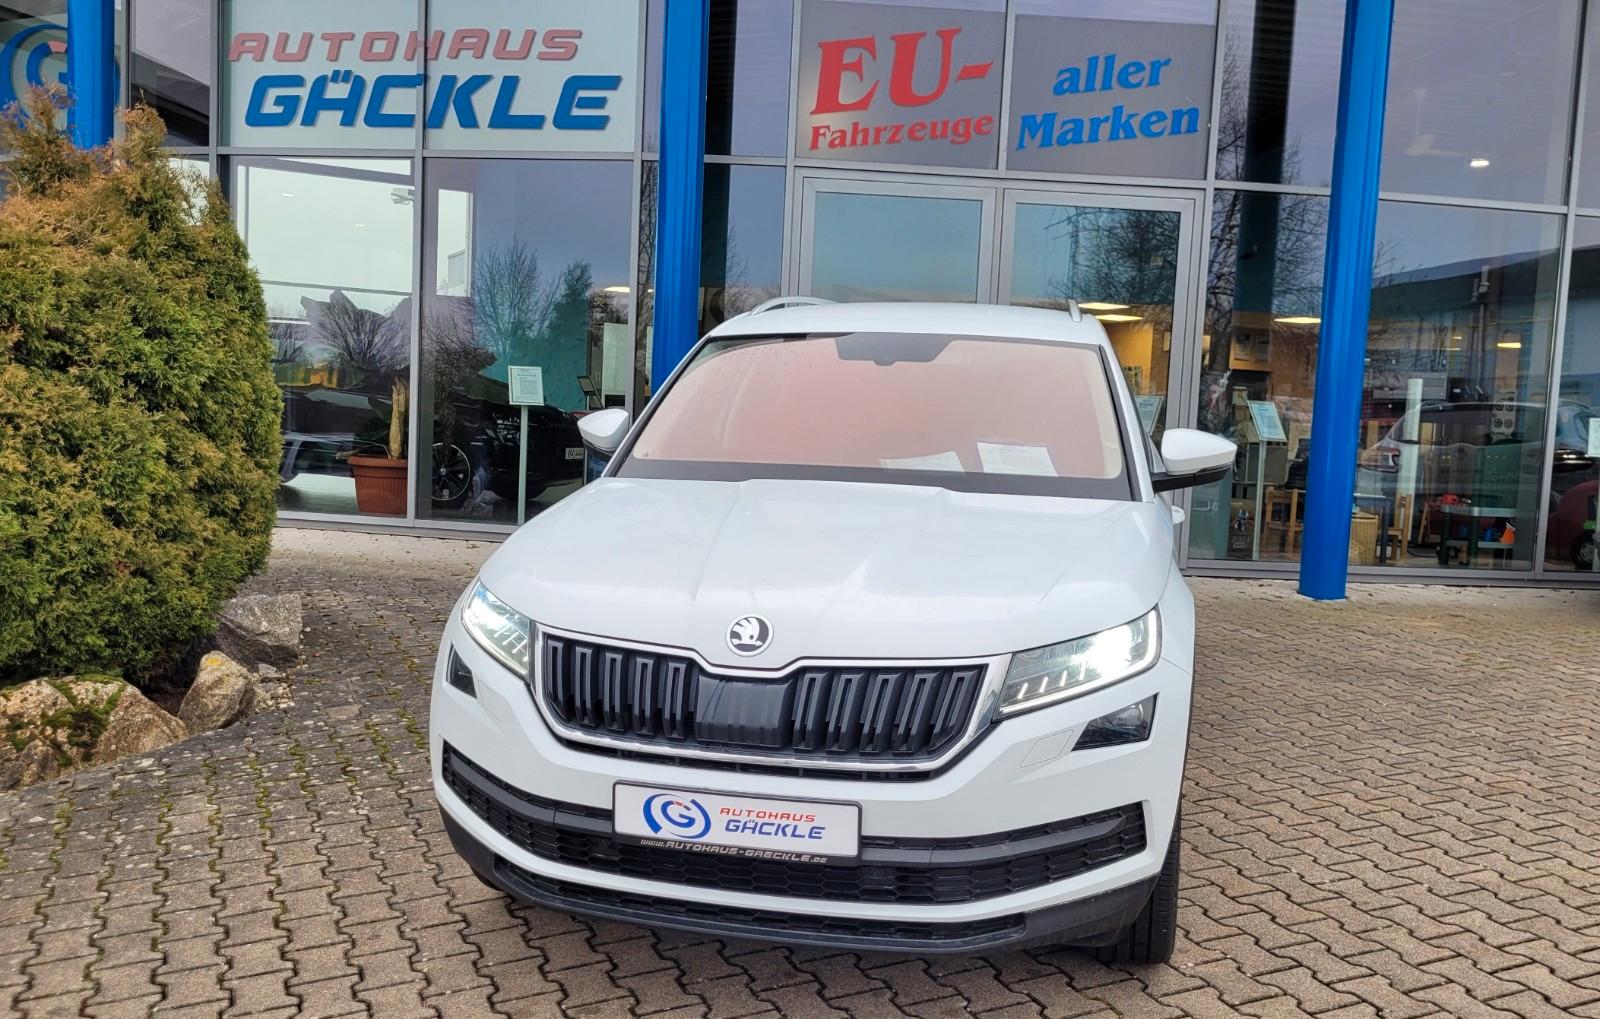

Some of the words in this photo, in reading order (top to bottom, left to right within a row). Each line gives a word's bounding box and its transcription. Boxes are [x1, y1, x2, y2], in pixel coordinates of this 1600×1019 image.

[228, 28, 582, 62] AUTOHAUS
[810, 28, 994, 116] EU-
[1053, 54, 1171, 96] aller
[244, 69, 622, 130] GÄCKLE
[809, 114, 994, 151] Fahrzeuge
[1016, 104, 1200, 150] Marken
[719, 807, 816, 823] AUTOHAUS
[725, 818, 826, 840] GÄCKLE
